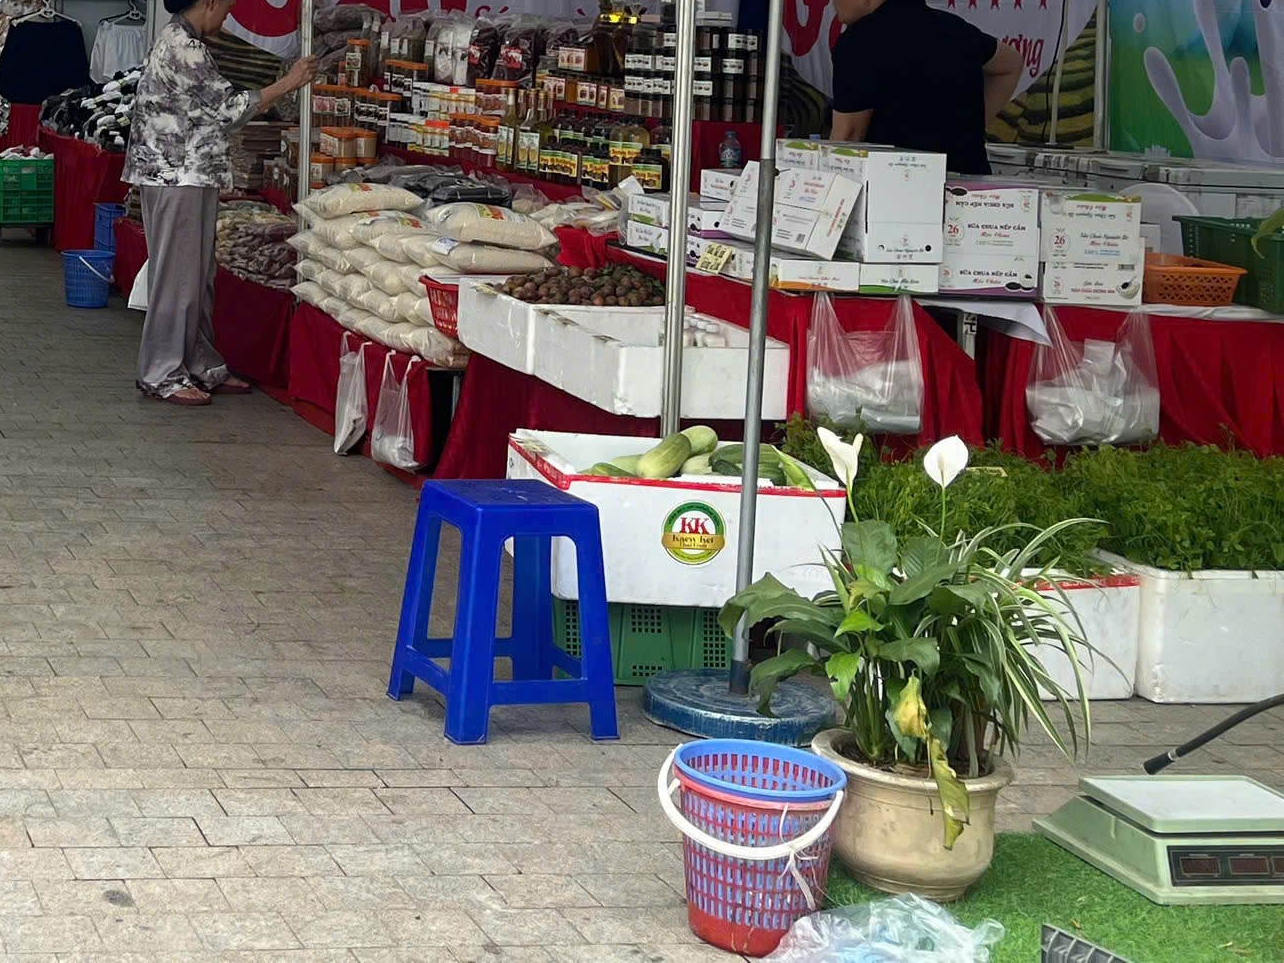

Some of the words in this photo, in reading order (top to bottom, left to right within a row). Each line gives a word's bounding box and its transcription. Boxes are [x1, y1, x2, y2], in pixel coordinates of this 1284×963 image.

[947, 224, 960, 235] 26
[1054, 234, 1066, 245] 26
[679, 516, 710, 535] KK
